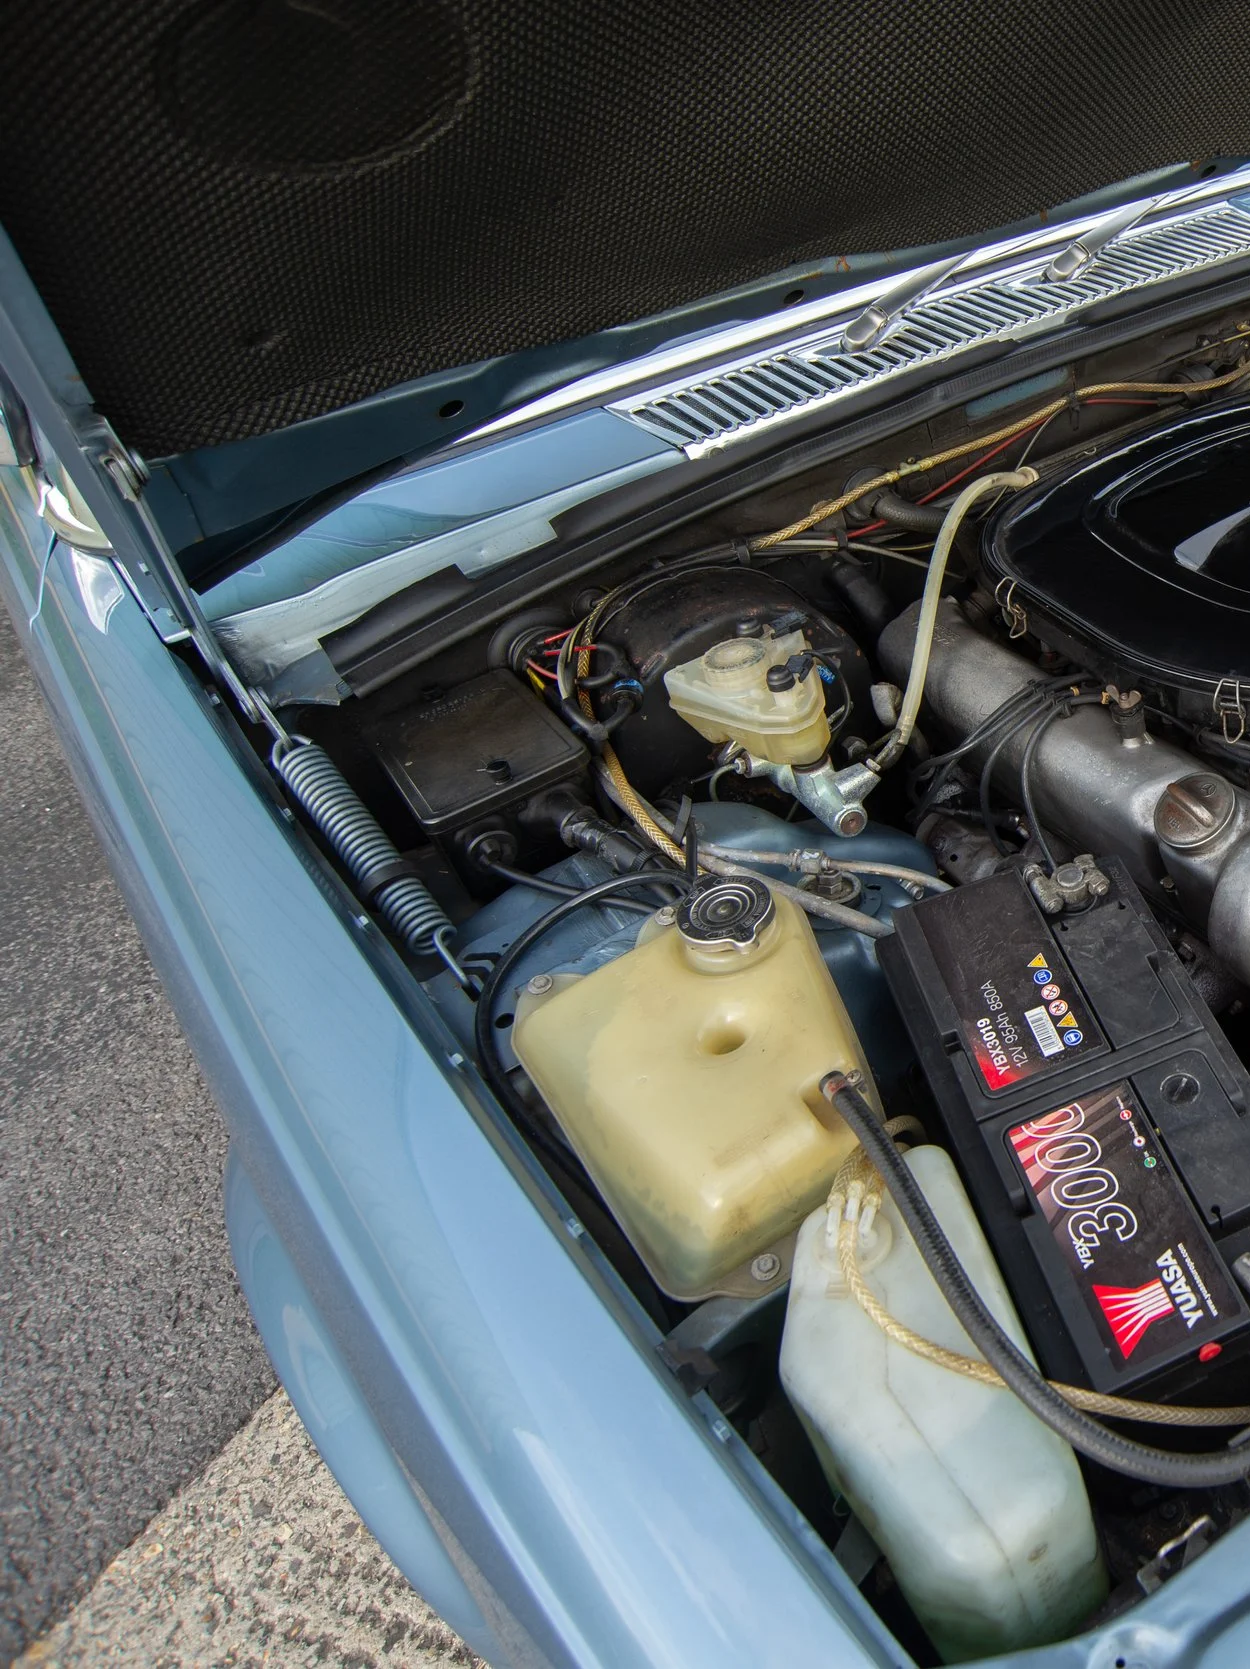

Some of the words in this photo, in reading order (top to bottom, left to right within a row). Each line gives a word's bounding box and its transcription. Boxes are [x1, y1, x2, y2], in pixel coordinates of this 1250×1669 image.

[980, 979, 1003, 1011] 850A
[975, 1016, 1011, 1074] YBX3019
[994, 1011, 1018, 1043] 95Ah
[1008, 1045, 1028, 1068] 12V
[1021, 1102, 1136, 1243] 3000
[1071, 1236, 1095, 1269] YBX
[1156, 1247, 1204, 1328] YUASA
[1177, 1242, 1218, 1316] www.yuasaeurope.com
